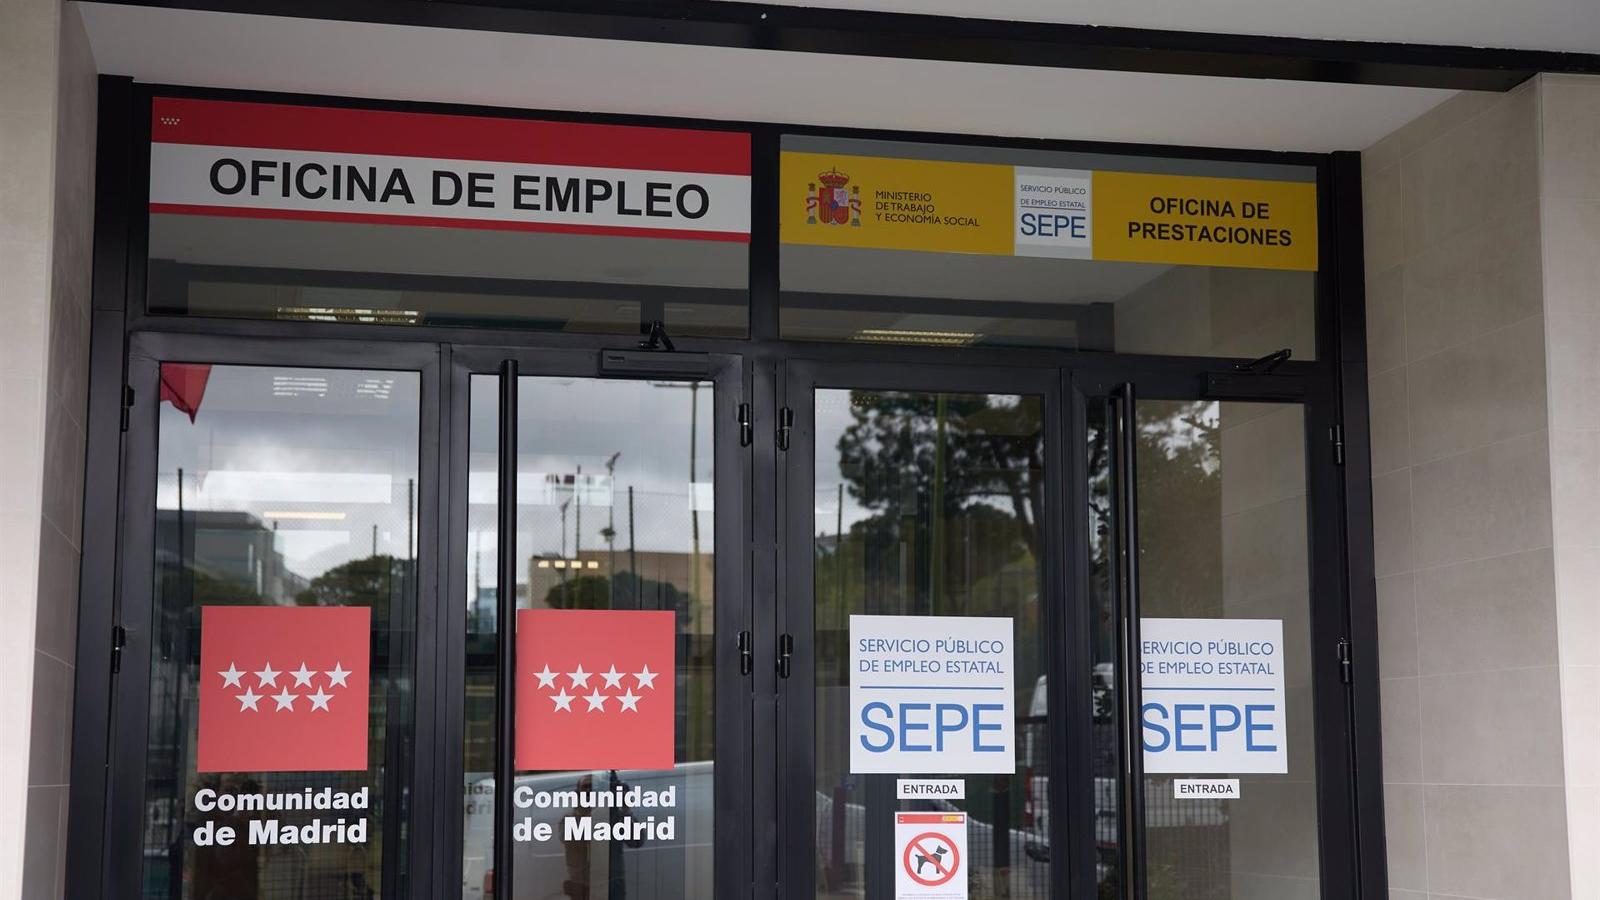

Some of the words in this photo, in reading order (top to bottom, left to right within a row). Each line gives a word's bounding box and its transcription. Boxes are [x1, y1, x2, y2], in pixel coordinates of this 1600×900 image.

[209, 158, 415, 204] OFICINA
[432, 170, 495, 208] DE
[513, 174, 710, 219] EMPLEO
[875, 190, 932, 202] MINISTERIO
[1020, 184, 1053, 193] SERVICIO
[1054, 184, 1087, 195] PÚBLICO
[875, 201, 889, 211] DE
[892, 202, 935, 214] TRABAJO
[1031, 199, 1058, 207] EMPLEO
[1059, 200, 1086, 208] ESTATAL
[1150, 197, 1236, 218] OFICINA
[1242, 202, 1270, 220] DE
[875, 213, 882, 221] Y
[885, 213, 941, 225] ECONOMÍA
[944, 216, 980, 227] SOCIAL
[1020, 213, 1087, 239] SEPE
[1128, 222, 1292, 247] PRESTACIONES
[859, 638, 930, 653] SERVICIO
[935, 635, 1004, 654] PÚBLICO
[1142, 641, 1203, 655] ERVICIO
[1208, 638, 1274, 656] PÚBLICO
[859, 659, 879, 673] DE
[884, 660, 941, 673] EMPLEO
[946, 661, 1005, 674] ESTATAL
[1159, 662, 1214, 675] EMPLEO
[1218, 662, 1275, 675] ESTATAL
[860, 701, 1006, 753] SEPE
[1141, 702, 1278, 753] SEPE
[513, 785, 676, 808] Comunidad
[903, 784, 959, 794] ENTRADA
[1180, 784, 1234, 794] ENTRADA
[194, 786, 369, 812] Comunidad
[193, 820, 236, 846] de
[248, 817, 368, 845] Madrid
[513, 817, 553, 842] de
[564, 815, 675, 841] Madrid
